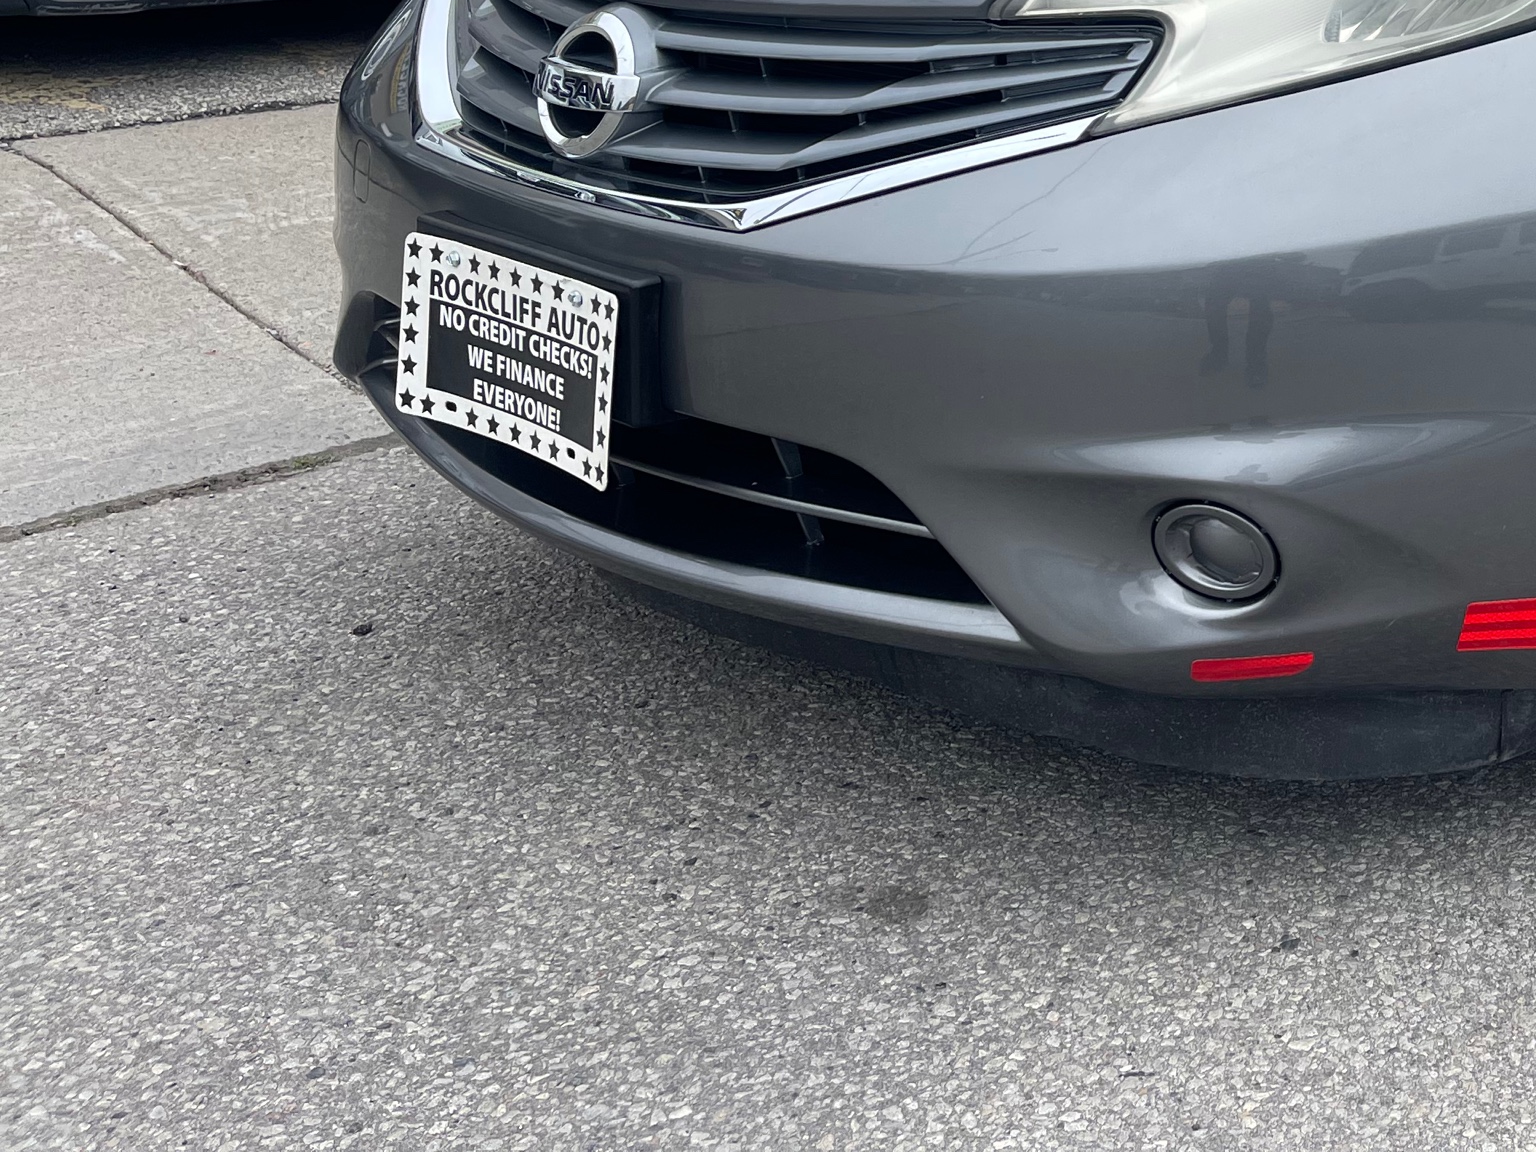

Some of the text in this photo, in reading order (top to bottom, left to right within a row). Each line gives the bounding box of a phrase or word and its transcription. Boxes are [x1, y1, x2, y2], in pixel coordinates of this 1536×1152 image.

[534, 64, 614, 105] NISSAN
[429, 269, 601, 351] ROCKCLIFF AUTO
[438, 307, 593, 380] NO CREDIT CHECKS!
[467, 344, 565, 402] WE FINANCE
[473, 379, 562, 433] EVERYONE!
